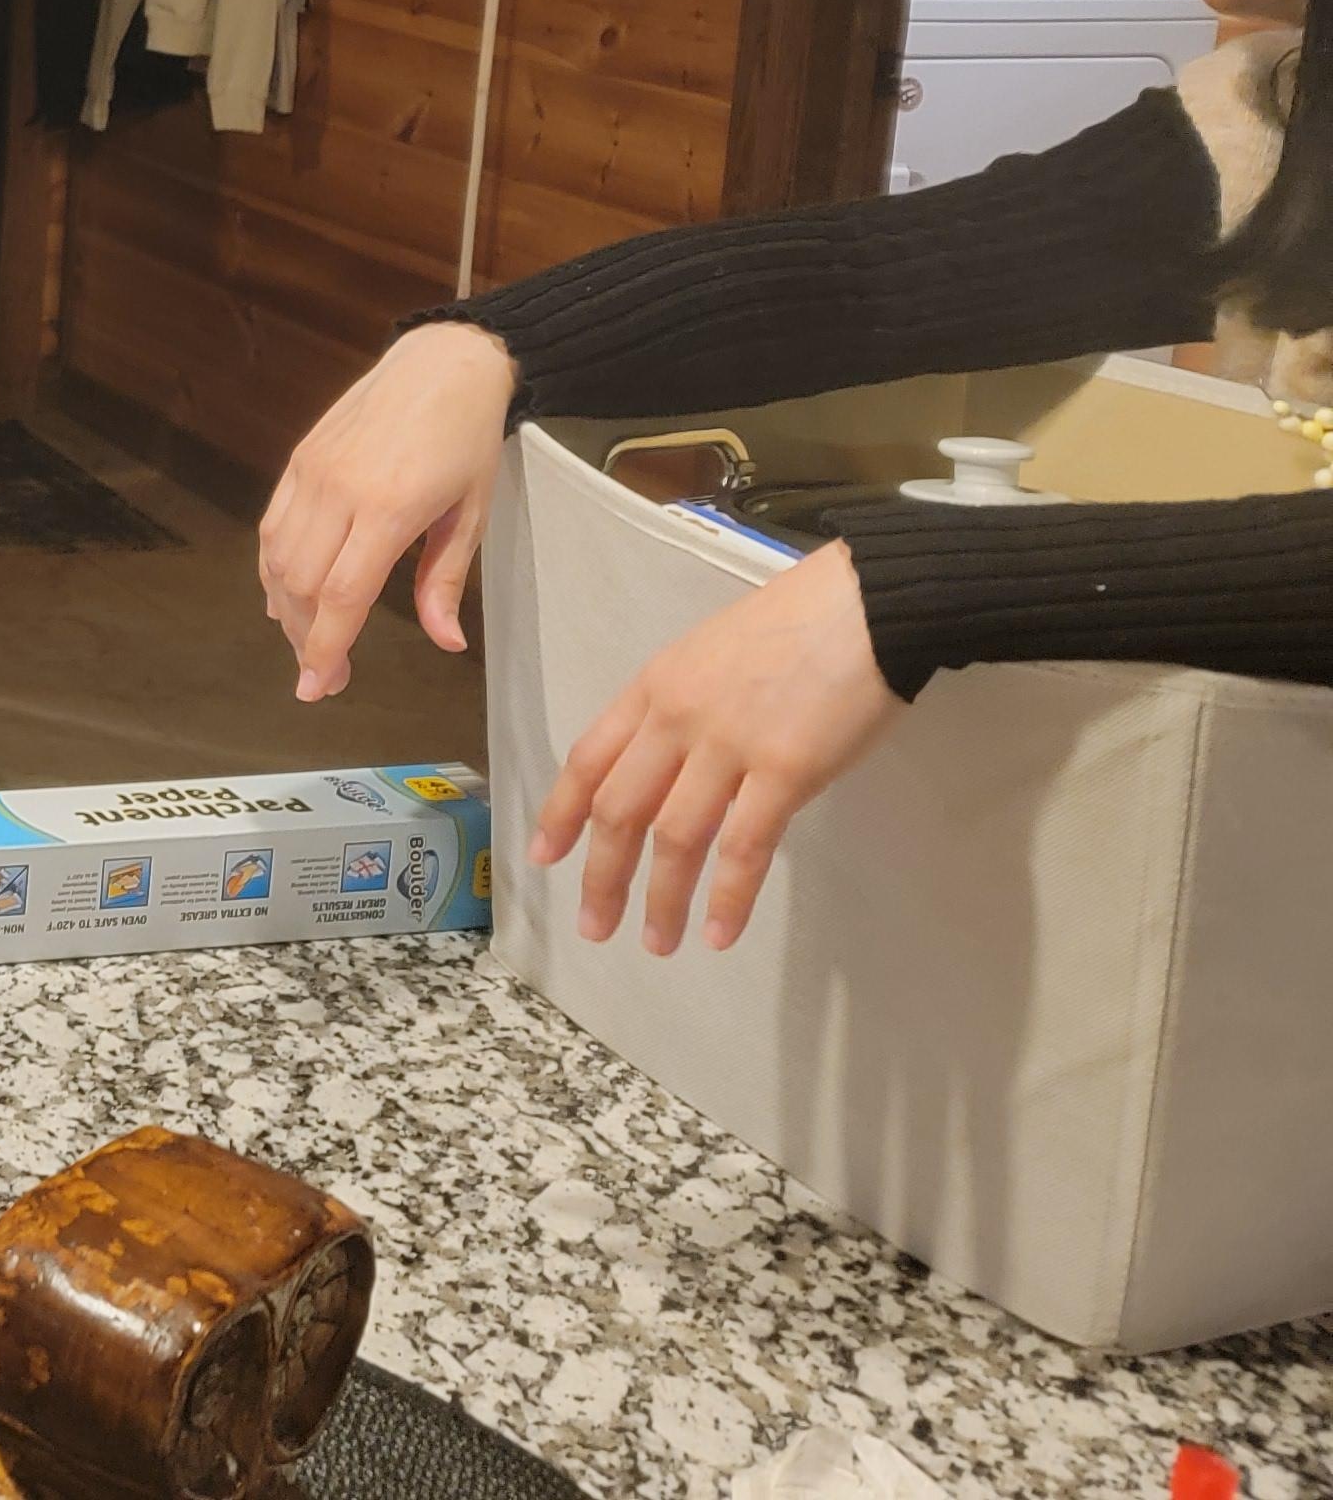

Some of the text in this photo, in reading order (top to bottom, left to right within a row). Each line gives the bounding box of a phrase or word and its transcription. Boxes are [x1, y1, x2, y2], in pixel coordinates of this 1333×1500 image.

[116, 786, 243, 806] Paper
[74, 797, 313, 827] Parchment
[409, 836, 425, 920] Boulder
[312, 897, 386, 912] GREAT RESULTS
[121, 915, 147, 925] OVEN
[180, 906, 269, 922] NO EXTRA GREASE
[315, 908, 385, 923] CONSISTENTLY
[79, 918, 91, 929] TO
[95, 917, 119, 928] SAFE
